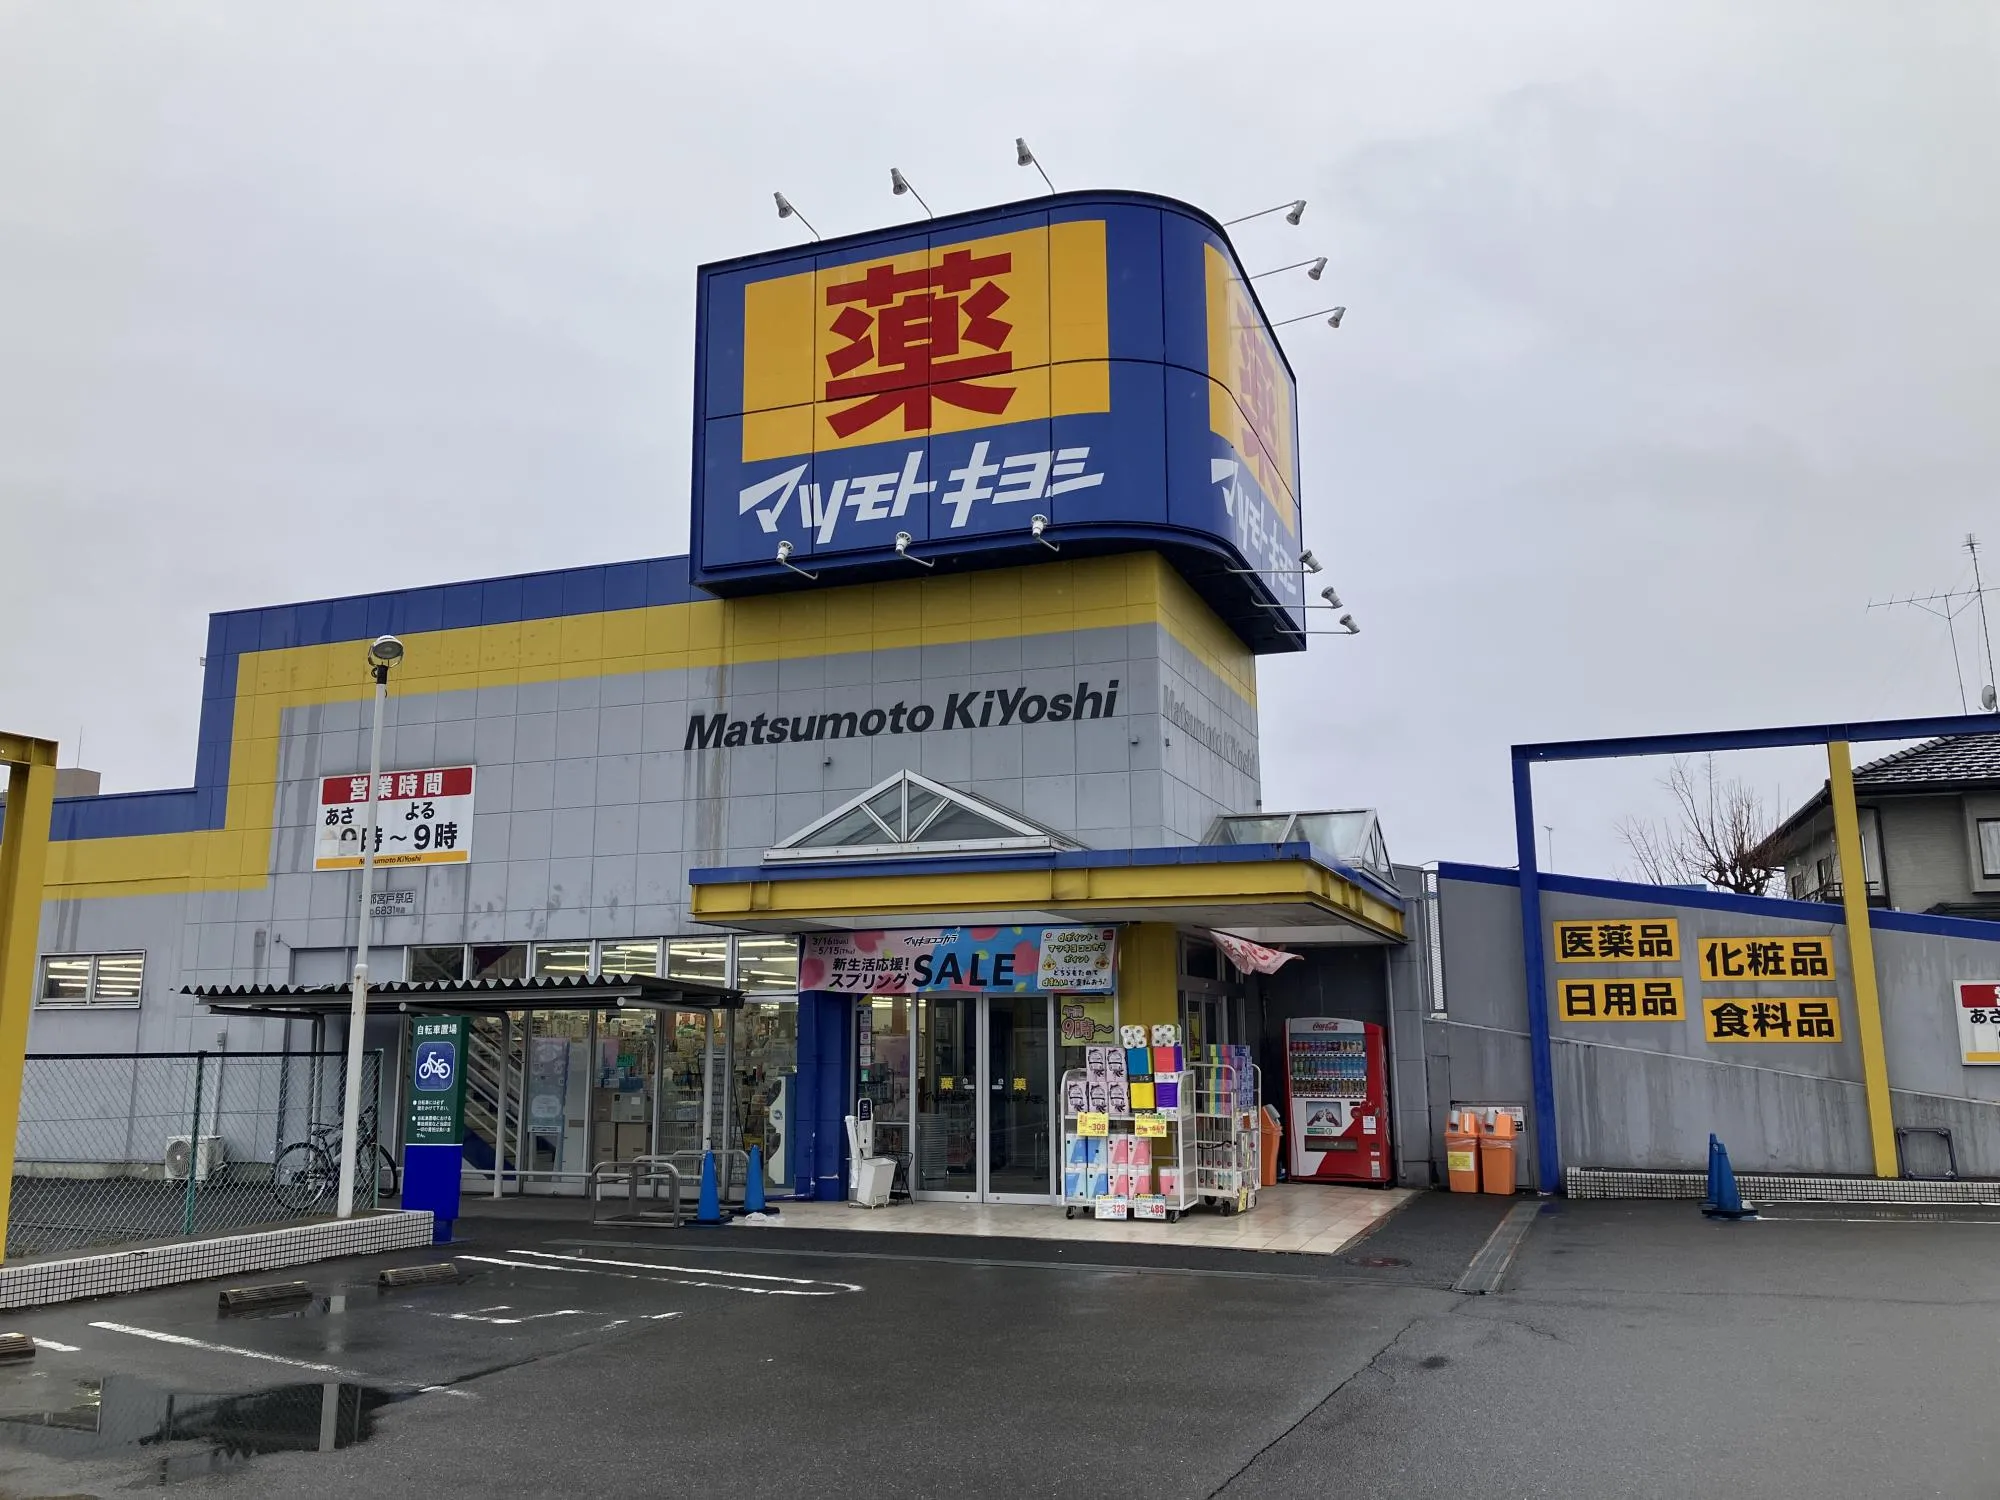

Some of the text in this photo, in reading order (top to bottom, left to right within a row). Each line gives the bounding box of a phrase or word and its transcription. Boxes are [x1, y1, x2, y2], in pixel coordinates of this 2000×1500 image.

[826, 249, 1017, 439] 薬
[739, 441, 1105, 545] マツモトキヨシ
[1210, 458, 1297, 596] マツモトキヨシ
[684, 679, 1119, 750] Matsumoto KiYoshi
[350, 772, 443, 801] 営業時間
[325, 801, 435, 826] あさ よる
[1560, 924, 1673, 959] 医薬品
[912, 953, 1016, 987] SALE
[1706, 942, 1829, 977] 化粧品
[829, 972, 909, 990] スプリング
[1565, 982, 1678, 1017] 日用品
[417, 1024, 458, 1035] 自転車置場
[1711, 1002, 1835, 1038] 食料品
